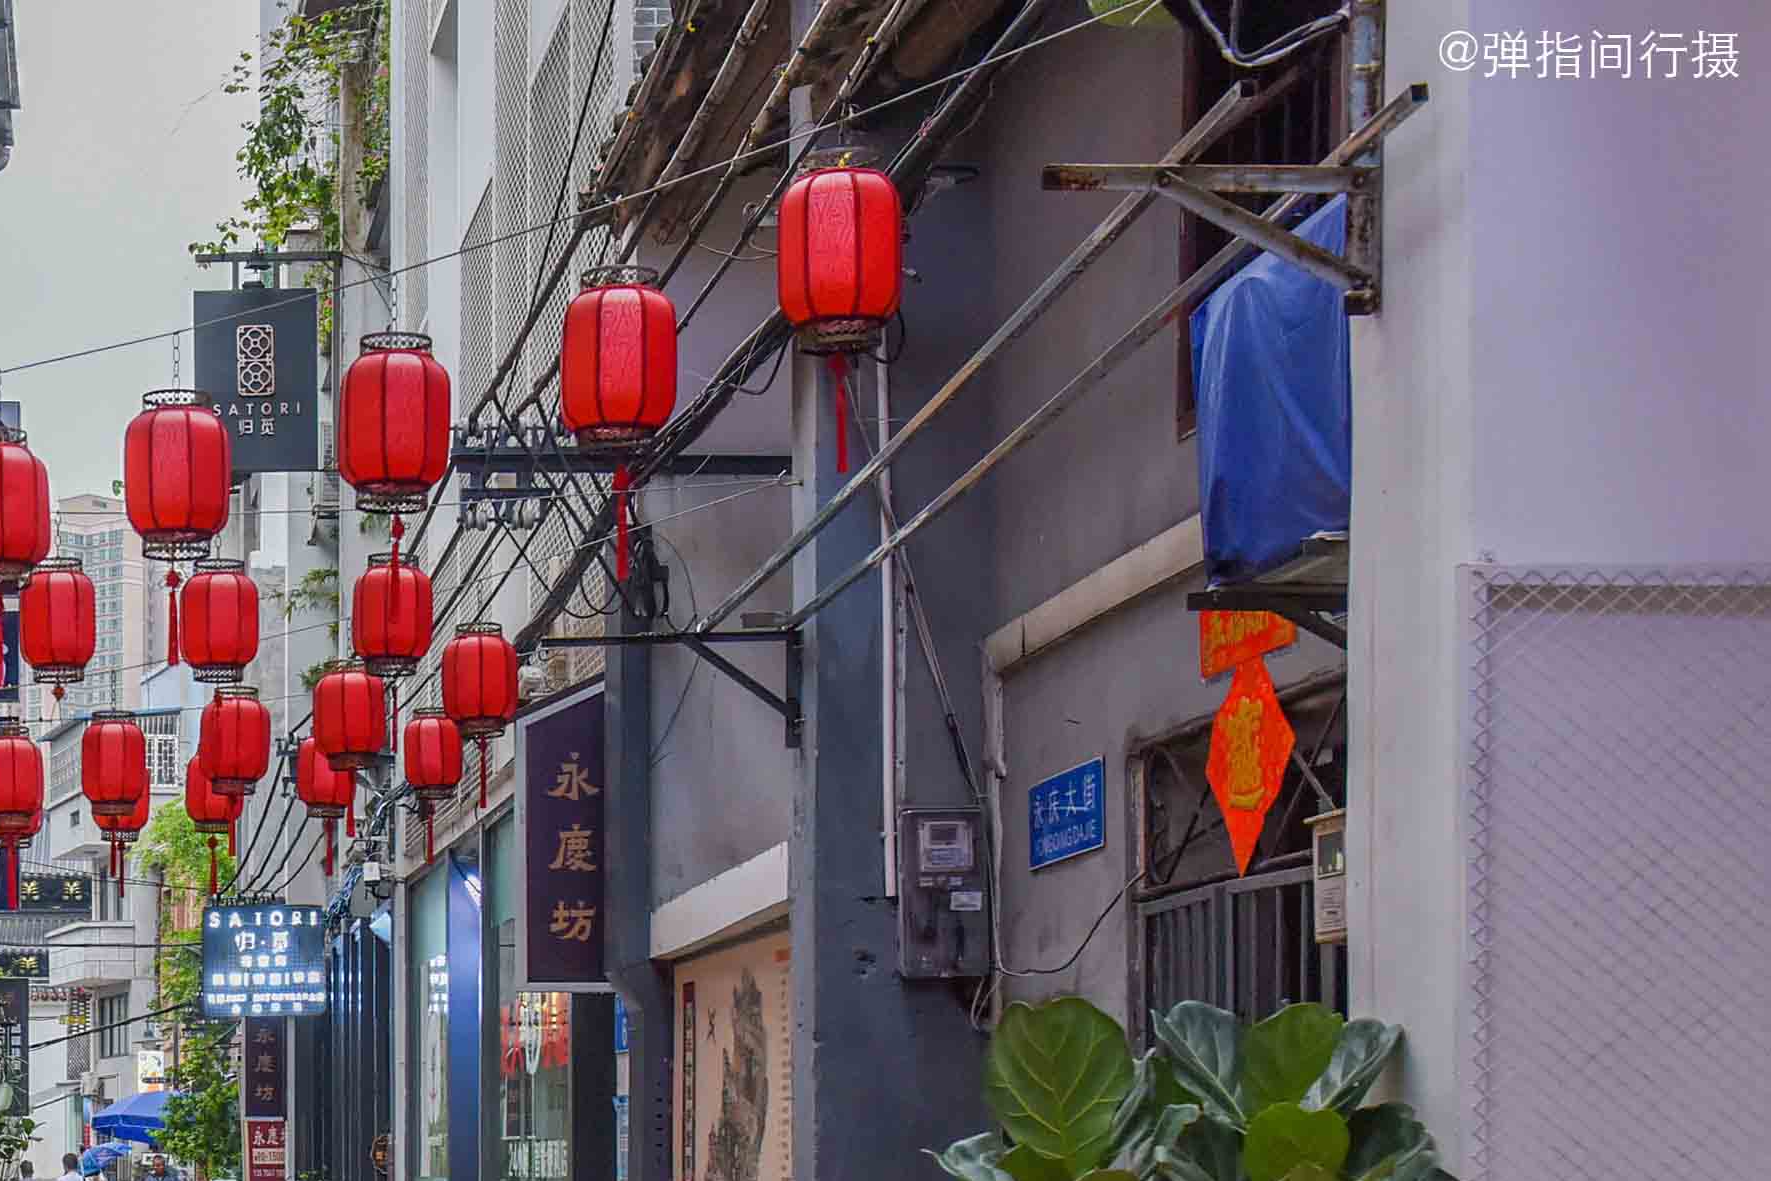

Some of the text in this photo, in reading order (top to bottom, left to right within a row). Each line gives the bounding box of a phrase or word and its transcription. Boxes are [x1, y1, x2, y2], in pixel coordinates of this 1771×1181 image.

[212, 401, 301, 417] SATORI
[546, 751, 601, 943] 永慶坊
